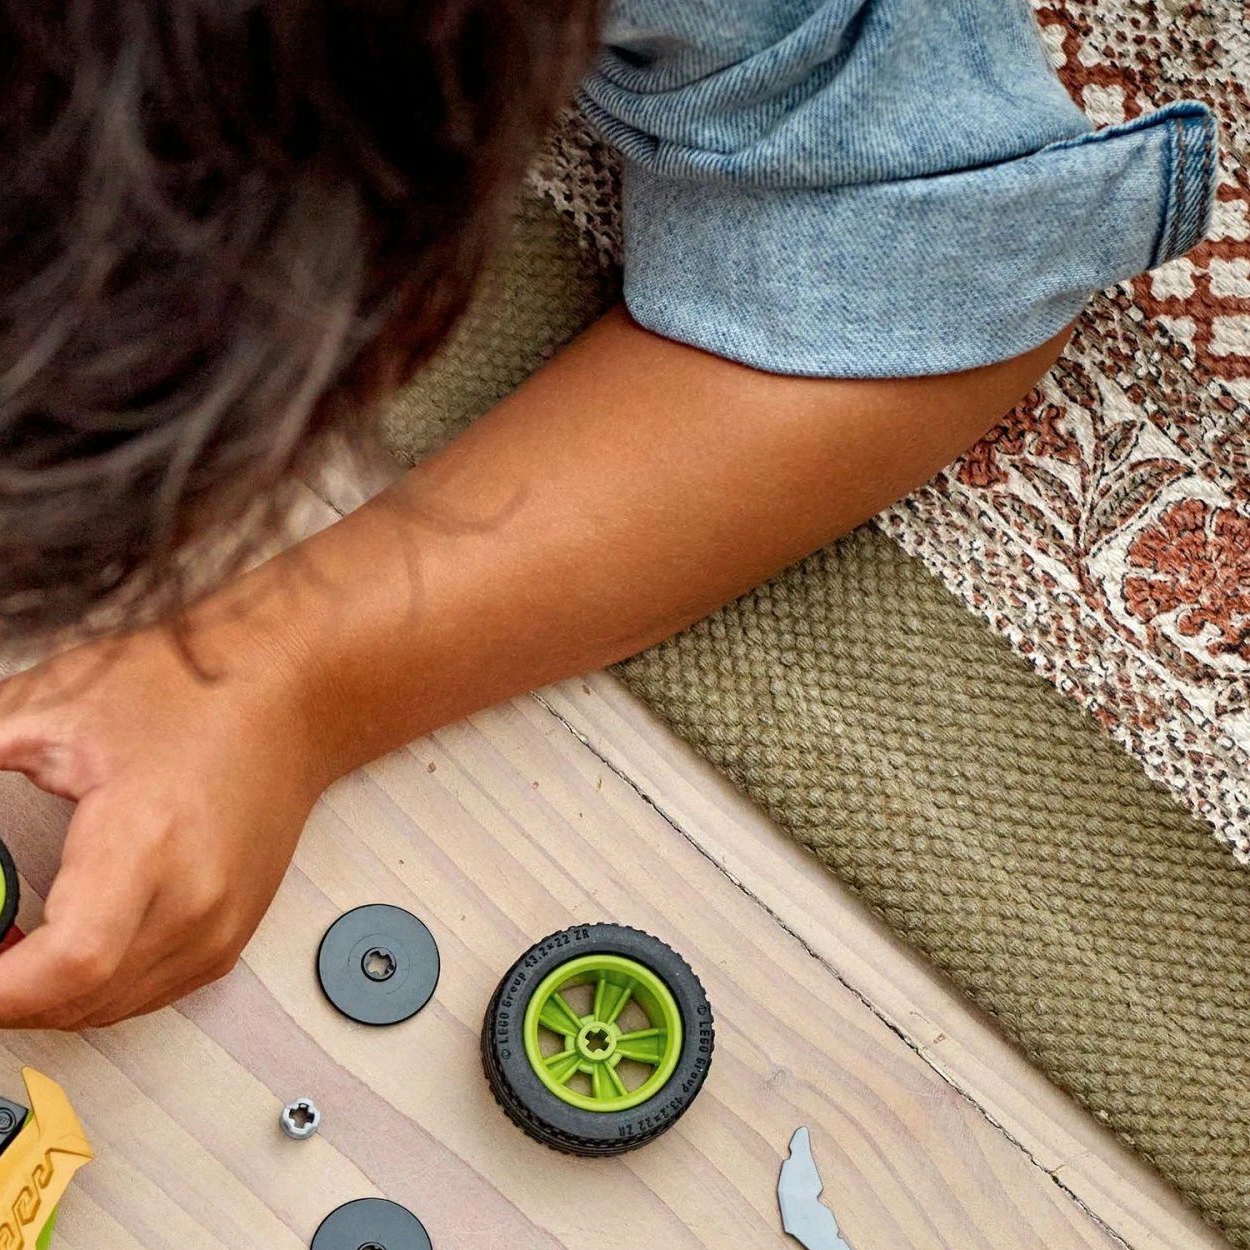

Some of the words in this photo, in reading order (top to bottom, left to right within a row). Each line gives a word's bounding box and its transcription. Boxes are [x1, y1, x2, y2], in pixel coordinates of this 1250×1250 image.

[573, 928, 591, 941] ZR
[502, 972, 527, 1008] Group
[498, 1012, 510, 1045] LEGO
[699, 1021, 711, 1054] LEGO
[682, 1057, 707, 1093] Group
